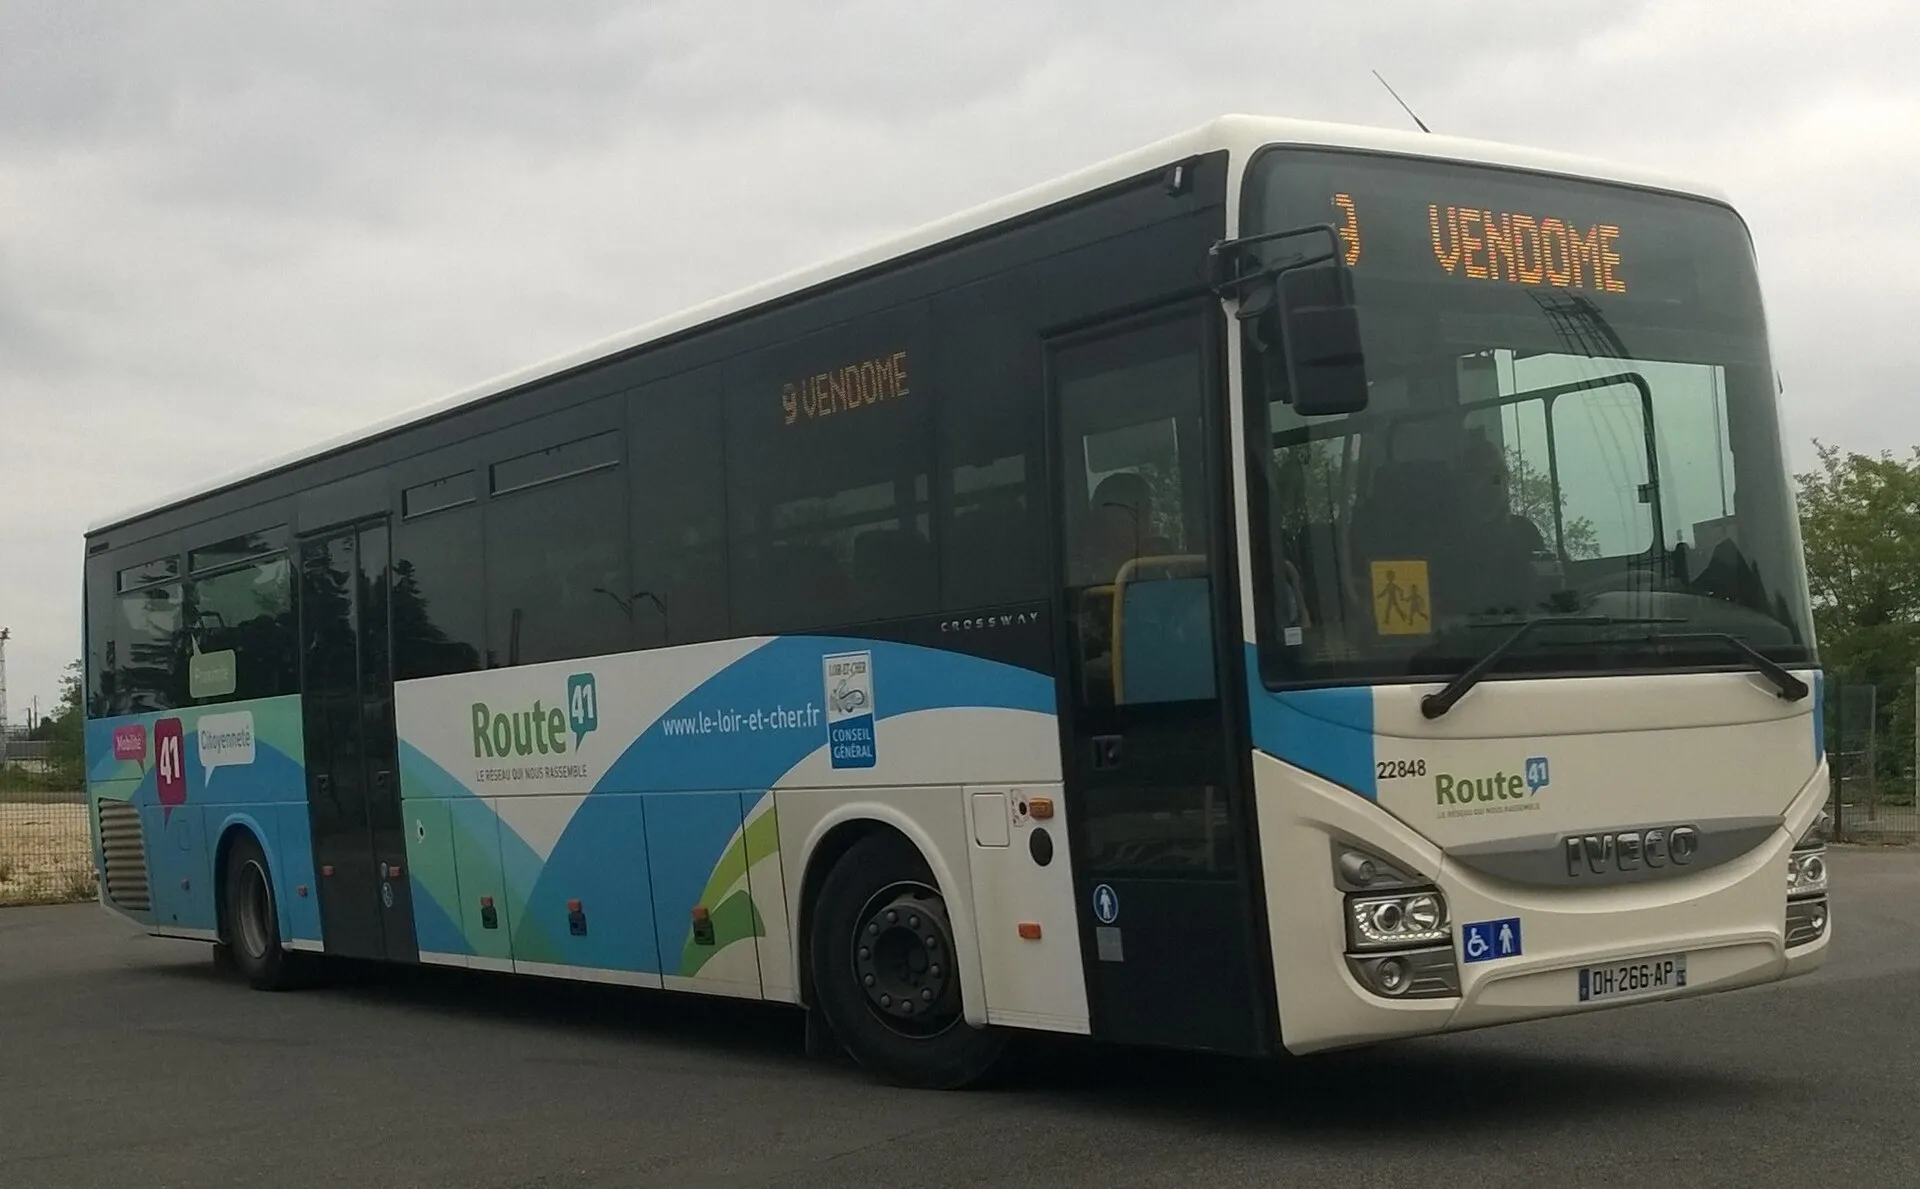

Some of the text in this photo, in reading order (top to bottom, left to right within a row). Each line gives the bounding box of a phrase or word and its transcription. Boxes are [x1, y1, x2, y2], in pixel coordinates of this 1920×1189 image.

[1428, 203, 1626, 293] VENDOME
[802, 351, 910, 419] VENDOME
[940, 612, 1039, 633] CROSSWAY
[471, 684, 594, 758] Route 41
[662, 702, 821, 737] www.le-loir-et-cher.fr
[832, 727, 872, 742] CONSEIL
[201, 725, 251, 754] Citoyenneté
[833, 743, 873, 759] GÉNÉRAL
[160, 735, 180, 785] 41
[476, 768, 485, 782] LE
[512, 768, 524, 780] QUI
[525, 767, 544, 780] NOUS
[545, 764, 588, 779] RASSEMBLE
[1376, 759, 1427, 780] 22848
[1435, 762, 1547, 805] Route 41
[1566, 825, 1698, 877] IVECO
[1592, 961, 1673, 996] DH-266-AP
